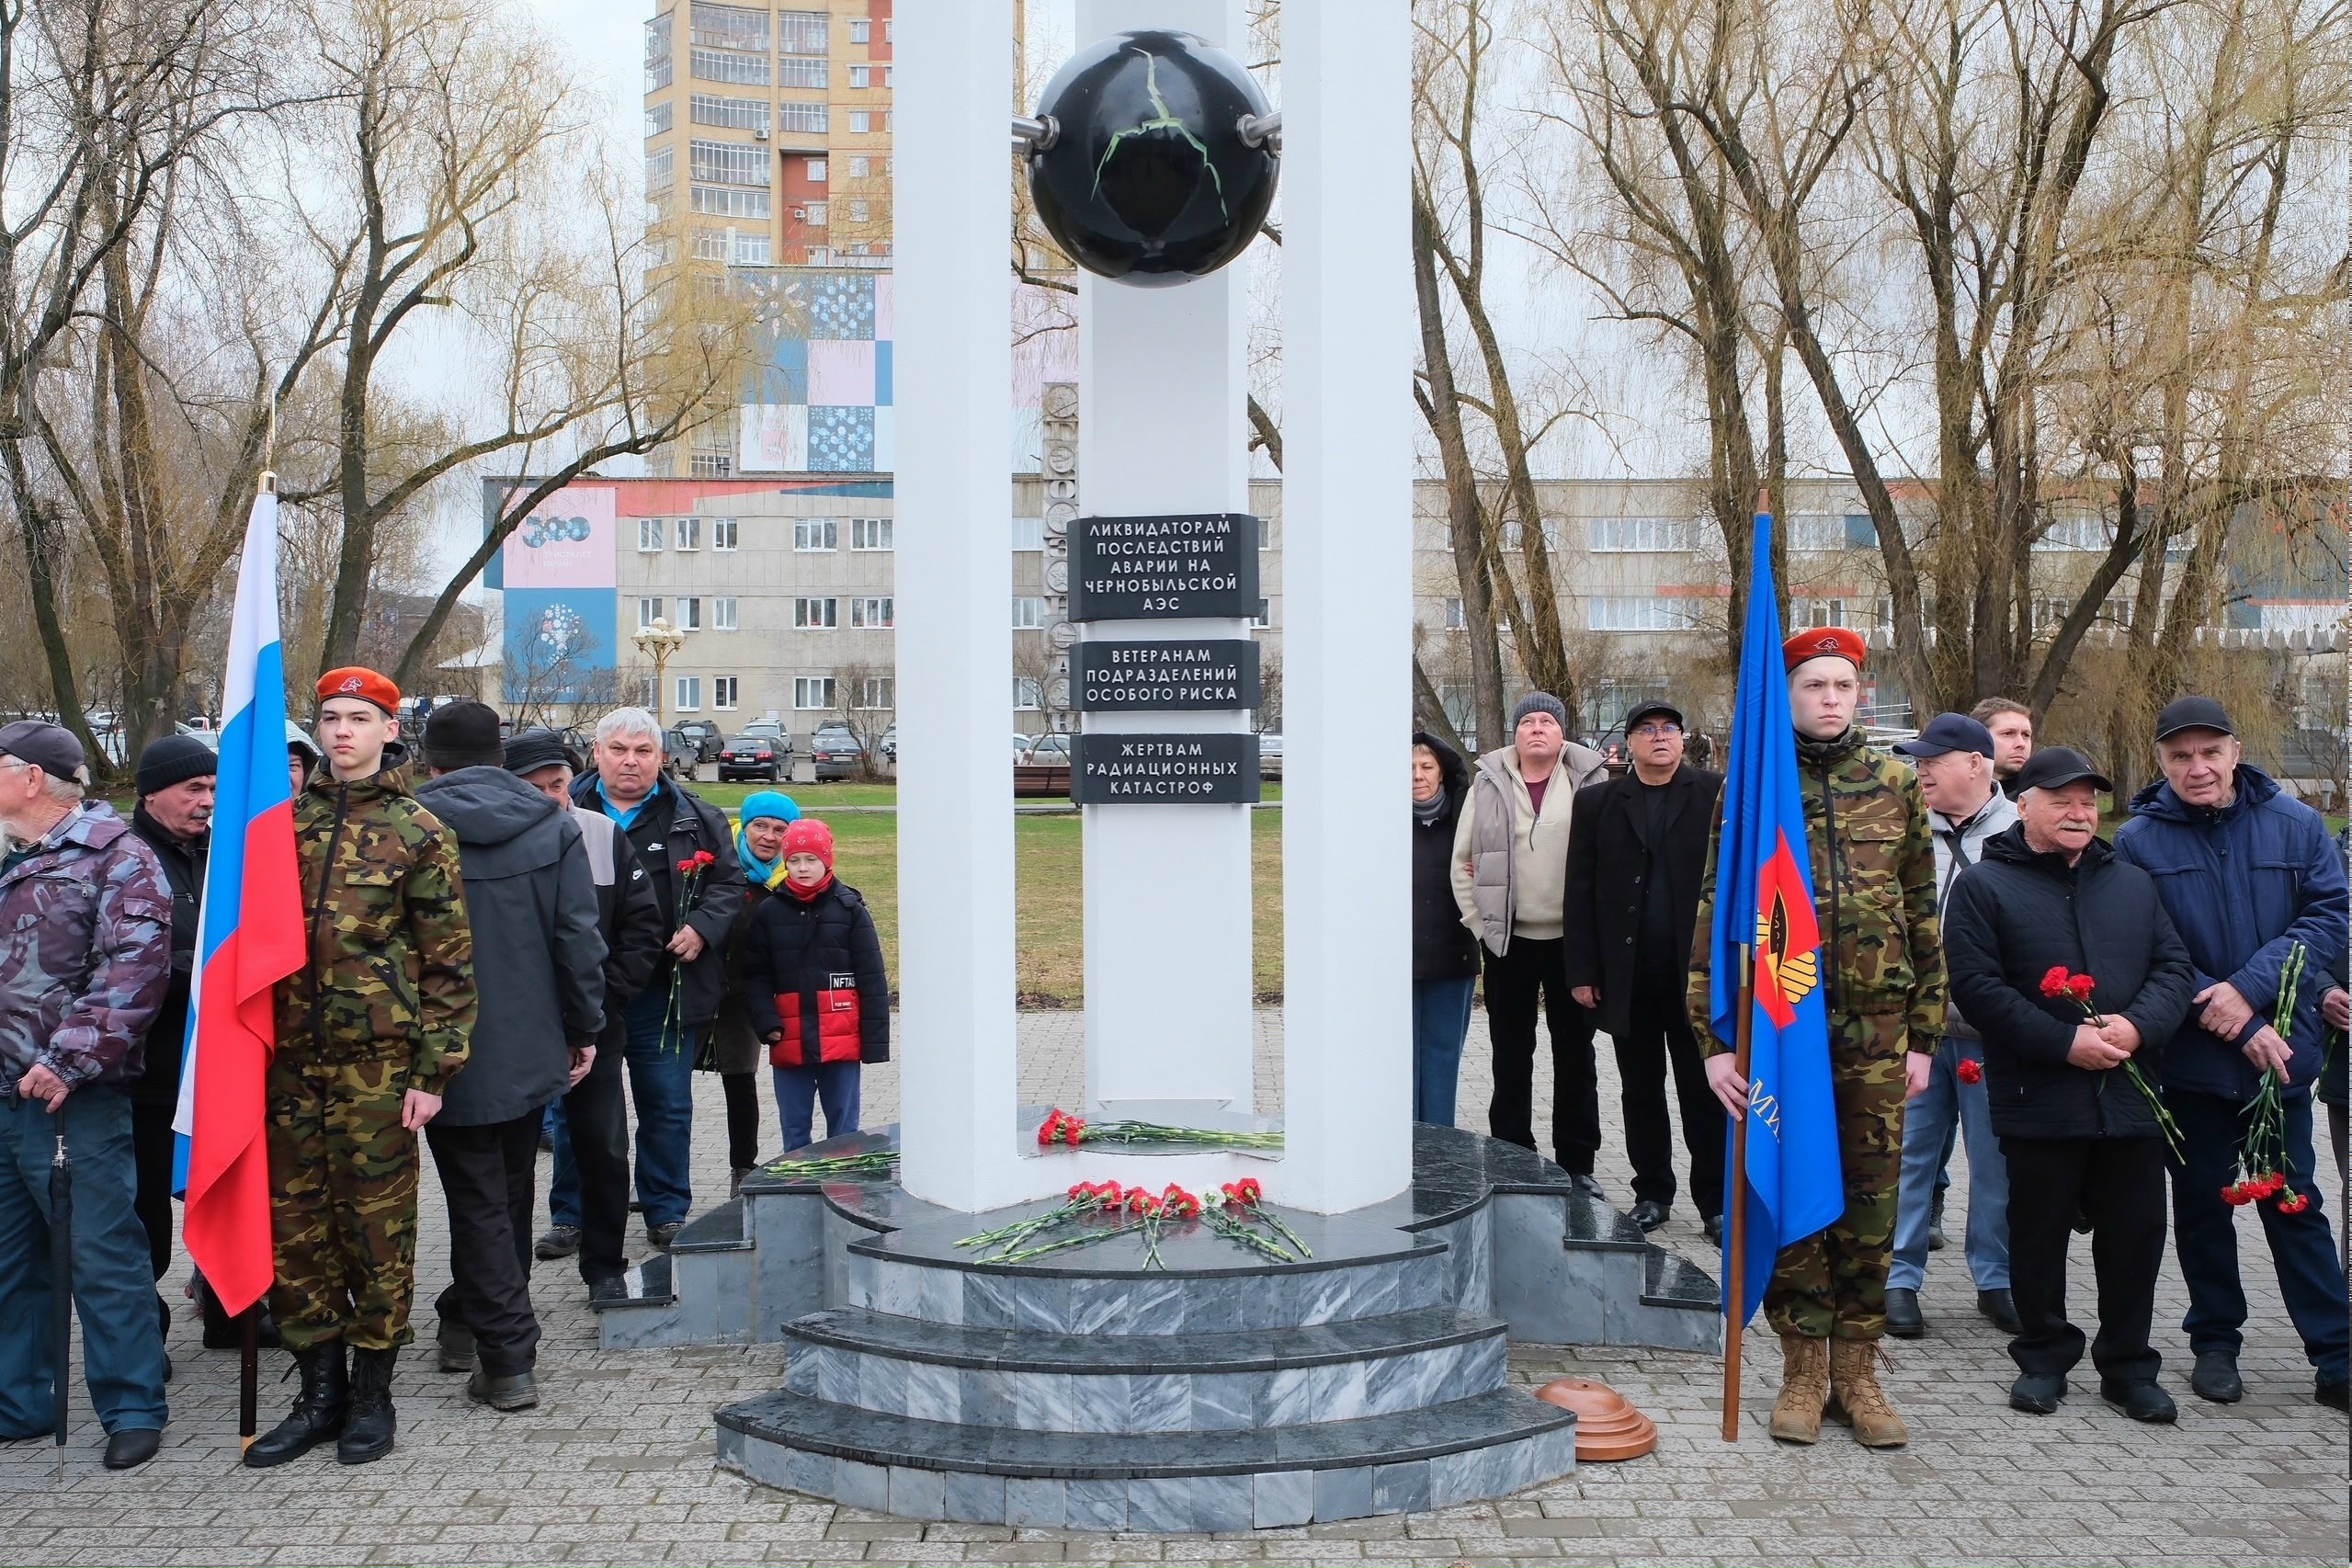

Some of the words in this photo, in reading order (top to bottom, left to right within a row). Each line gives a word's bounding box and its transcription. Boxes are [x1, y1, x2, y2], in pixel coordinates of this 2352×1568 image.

[1089, 520, 1231, 537] ЛИКВИДАТОРАМ
[1096, 536, 1224, 555] ПОСЛЕДСТВИЙ
[1110, 560, 1178, 574] АВАРИИ
[1188, 559, 1211, 573] НА
[1085, 573, 1237, 594] ЧЕРНОБЫЛЬСКОЙ
[1142, 597, 1180, 611] АЭС
[1112, 649, 1211, 664] ВЕТЕРАНАМ
[1085, 665, 1237, 684] ПОДРАЗДЕЛЕНИЙ
[1086, 688, 1174, 702] ОСОБОГО
[1179, 687, 1237, 701] РИСКА
[1121, 743, 1202, 756] ЖЕРТВАМ
[1086, 762, 1237, 777] РАДИАЦИОННЫХ
[1109, 781, 1214, 795] КАТАСТРОФ
